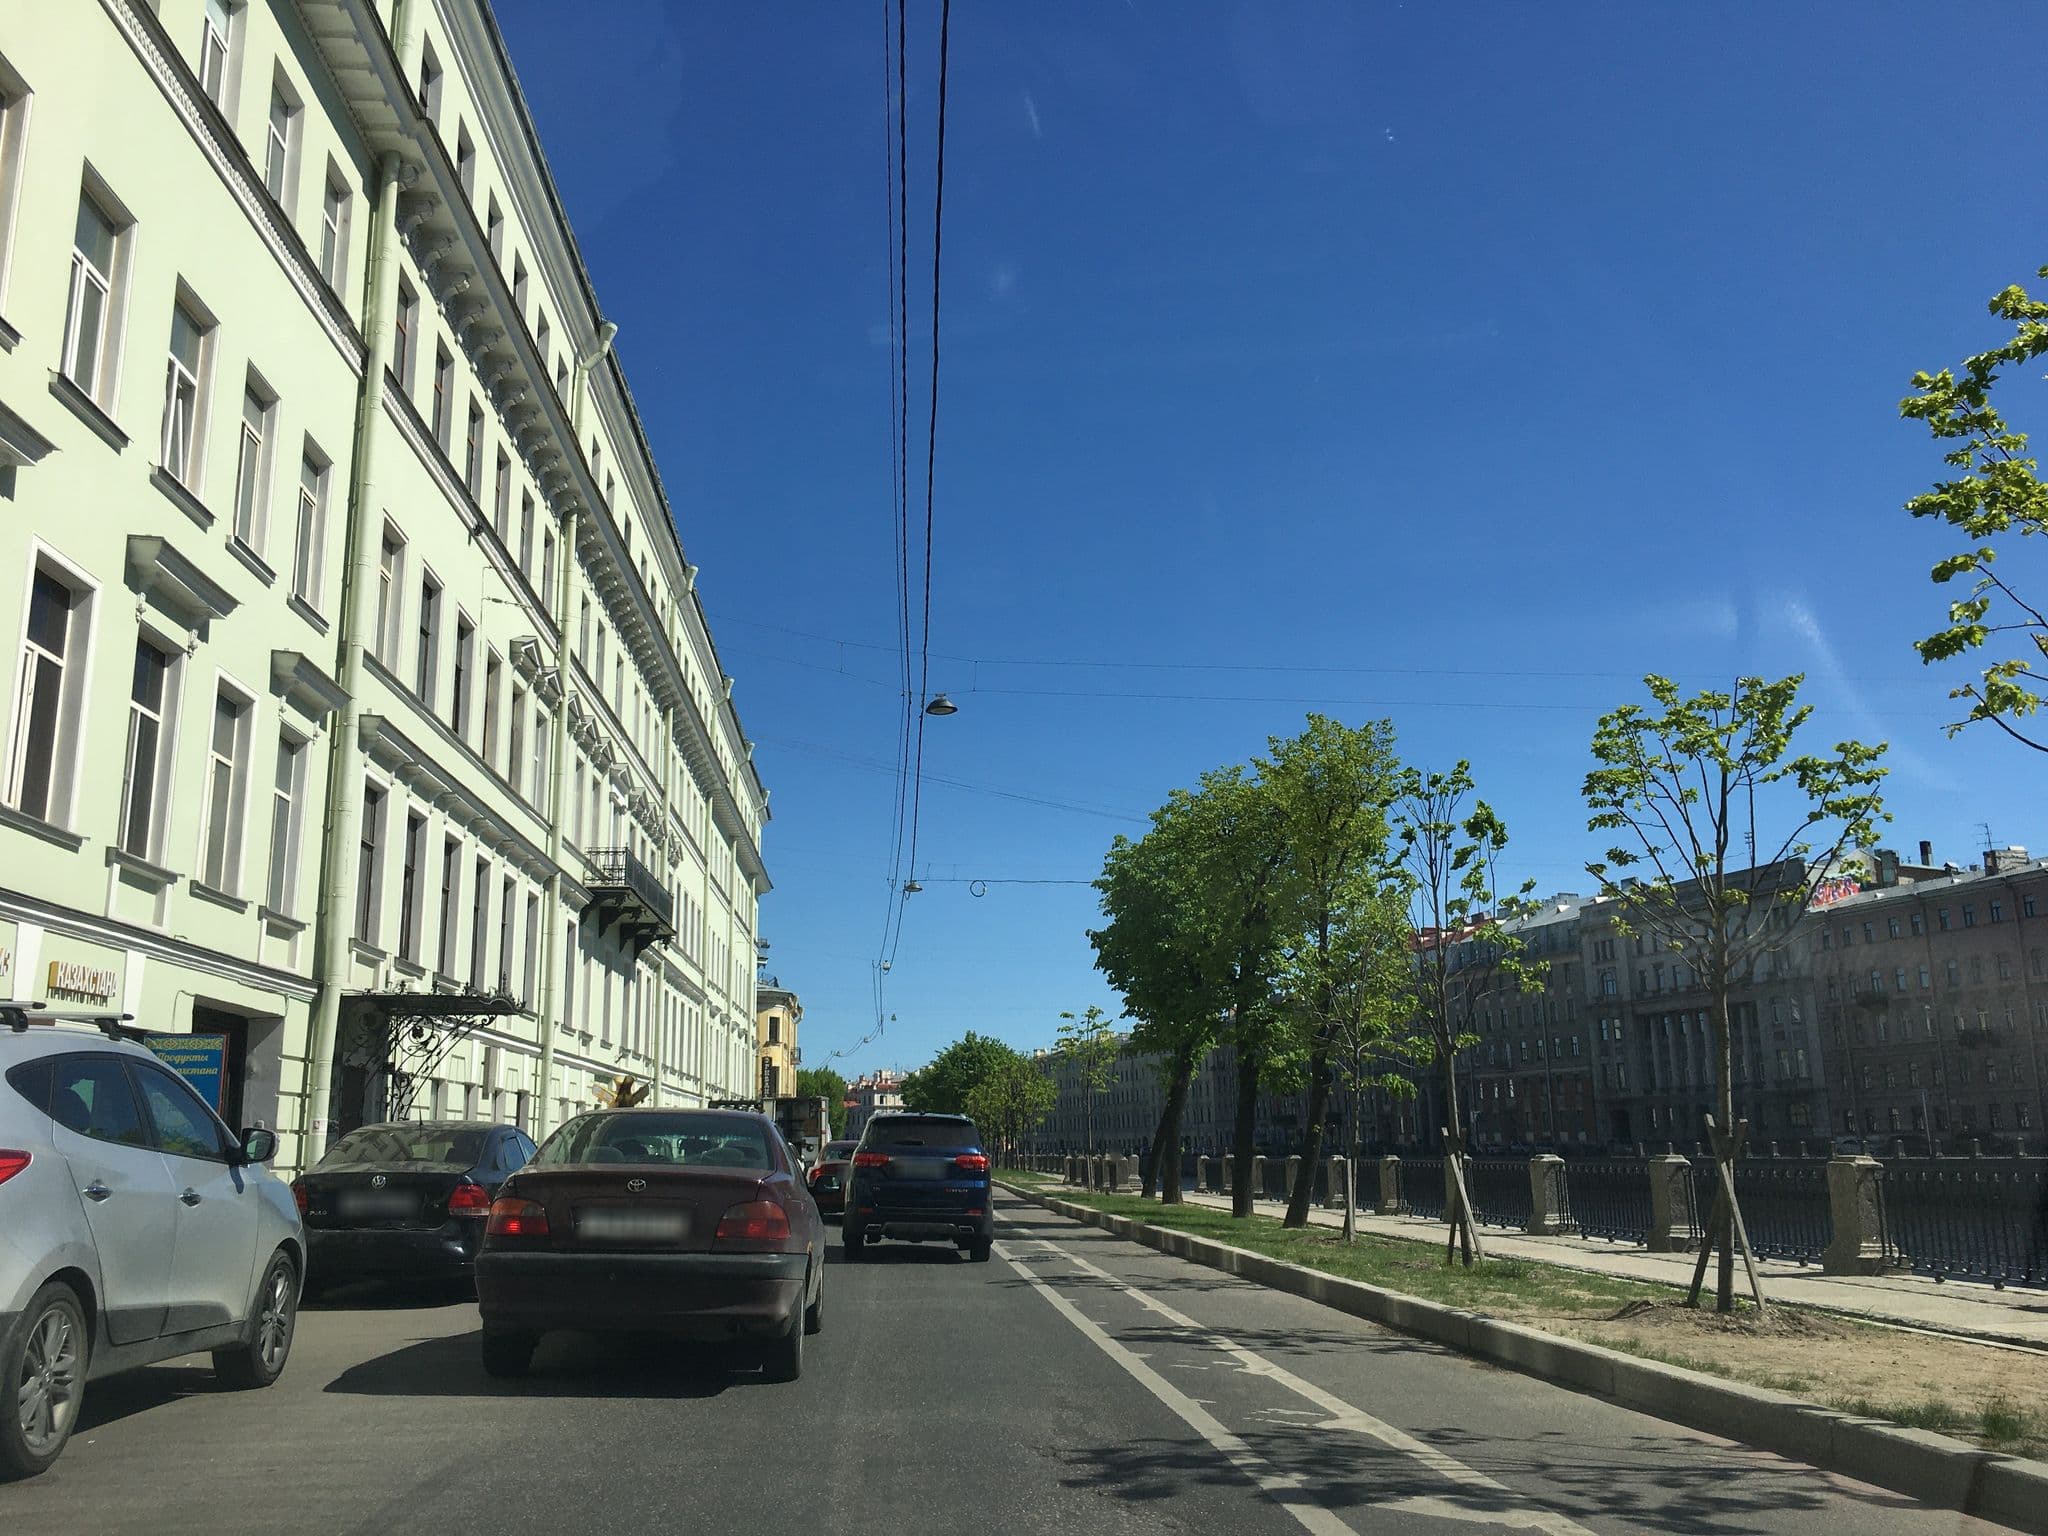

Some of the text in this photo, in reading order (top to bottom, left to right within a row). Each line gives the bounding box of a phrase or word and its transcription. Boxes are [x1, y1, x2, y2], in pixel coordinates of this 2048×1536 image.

[51, 961, 118, 997] КАЗАХСТАНА
[157, 1052, 209, 1064] Продукты
[176, 1067, 218, 1075] ахстана
